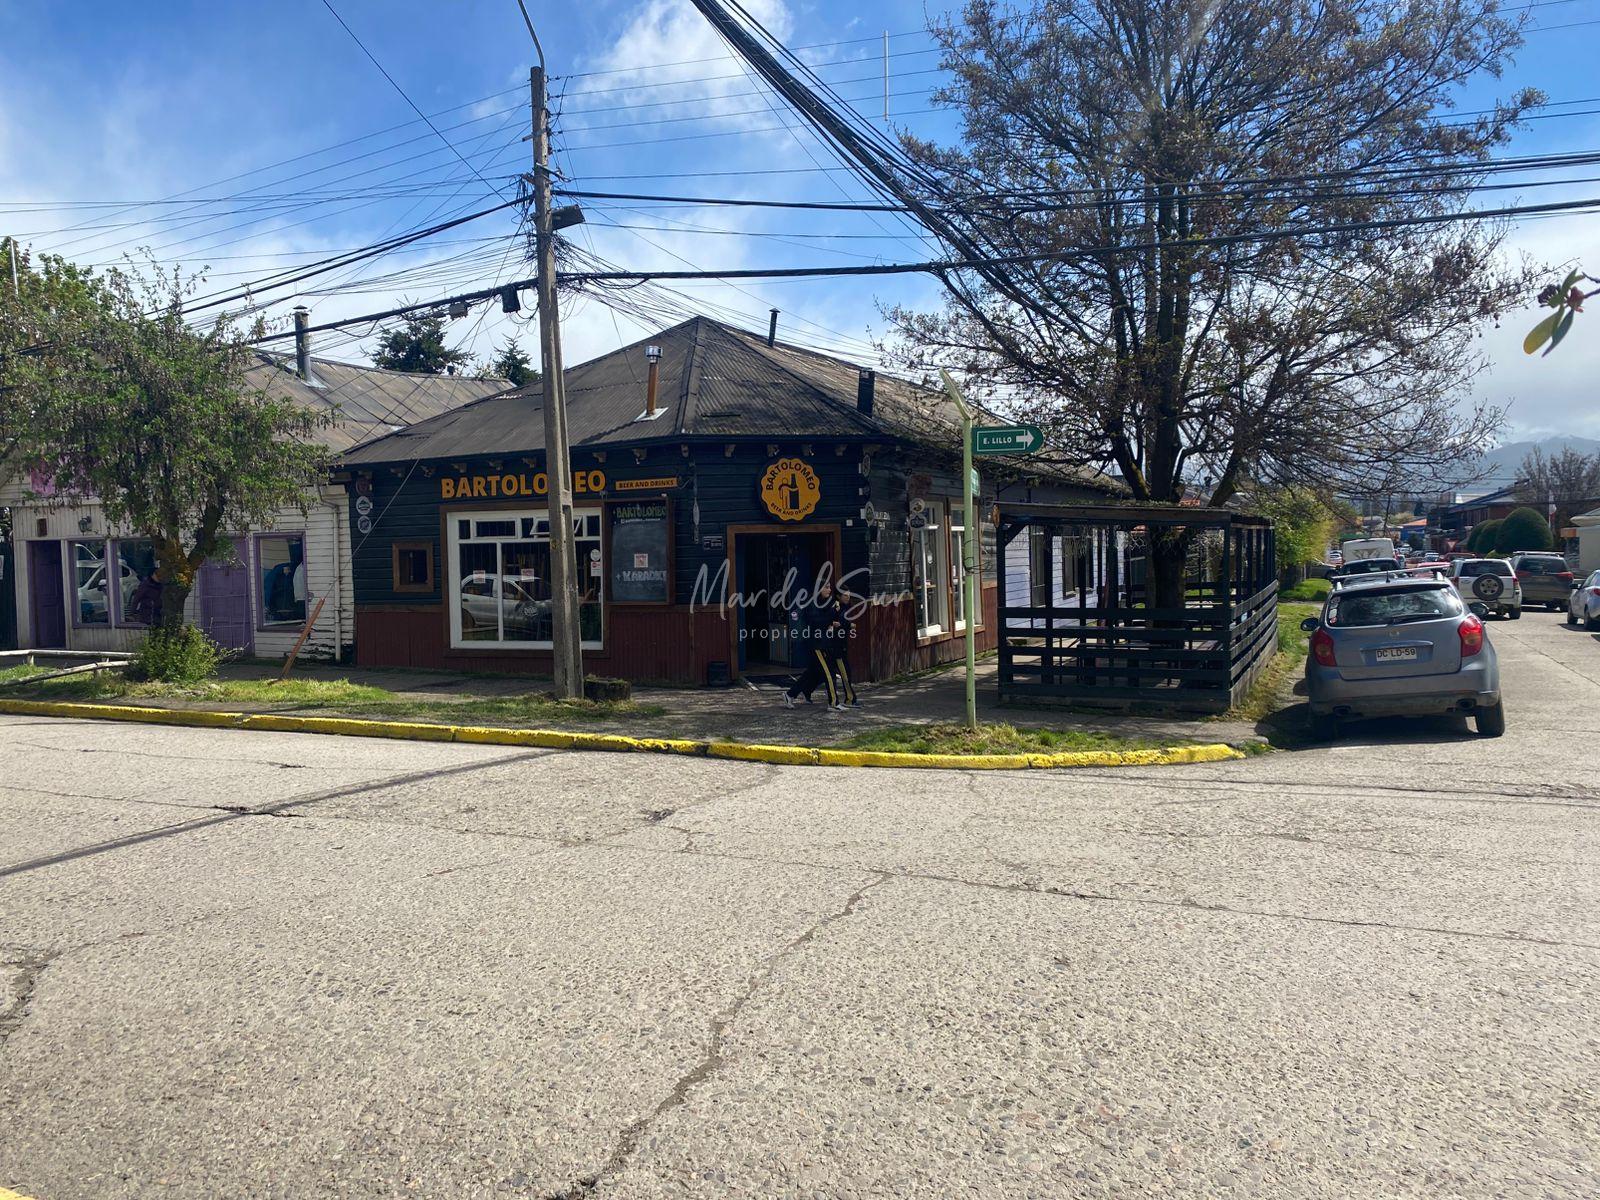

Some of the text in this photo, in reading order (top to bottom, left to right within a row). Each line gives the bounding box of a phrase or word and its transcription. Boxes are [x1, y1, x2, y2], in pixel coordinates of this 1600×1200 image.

[992, 436, 1012, 444] LILLO
[441, 470, 606, 499] BARTOLOEO
[635, 480, 650, 488] AND
[650, 479, 675, 487] DRINKS
[766, 461, 816, 490] BARTOLOMEO
